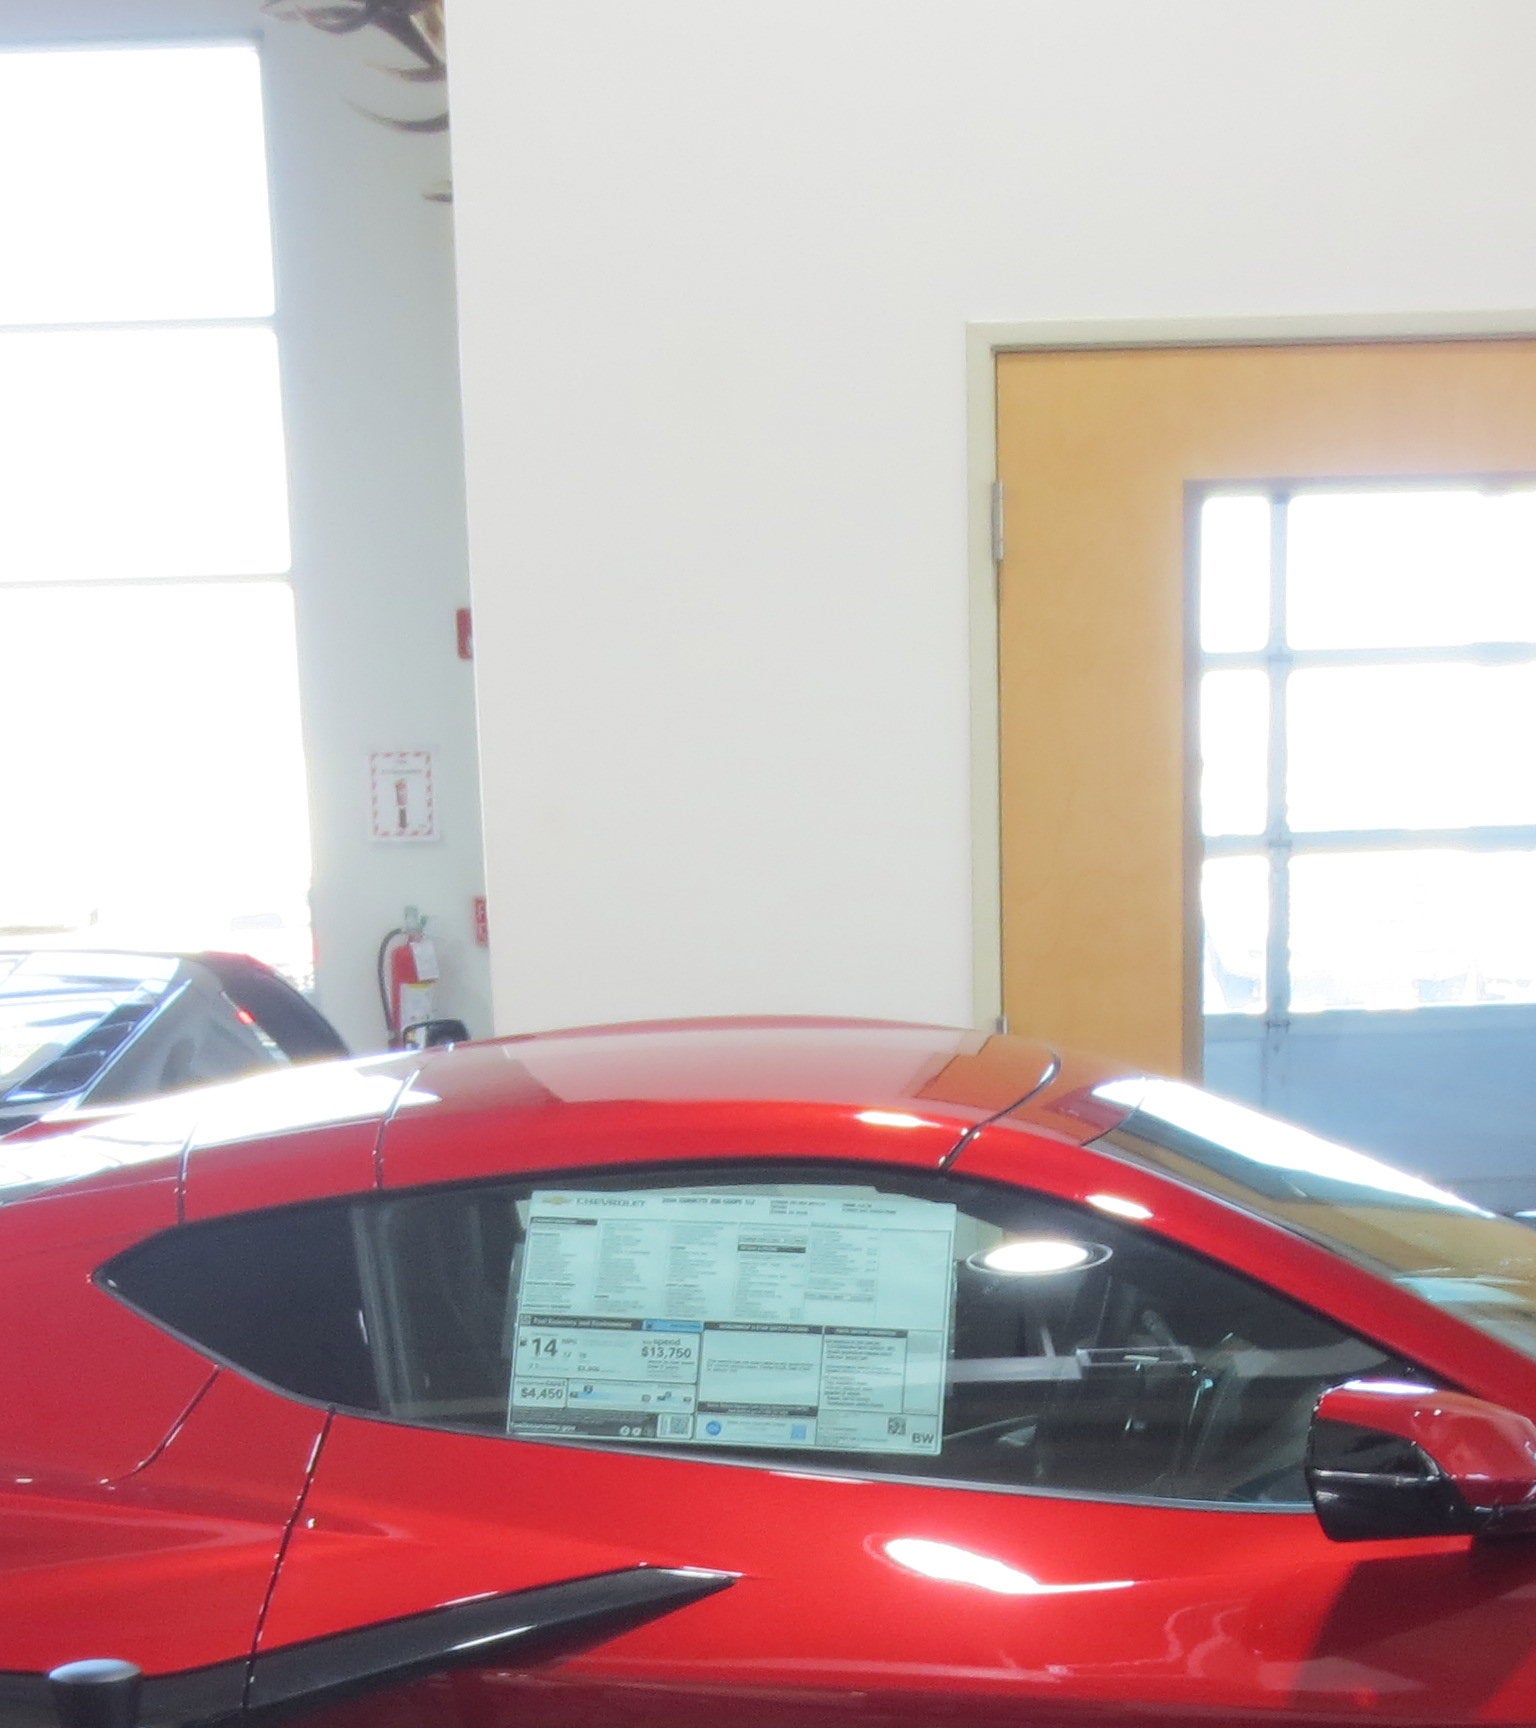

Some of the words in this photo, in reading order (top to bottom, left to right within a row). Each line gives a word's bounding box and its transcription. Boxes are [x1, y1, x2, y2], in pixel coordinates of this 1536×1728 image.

[575, 1197, 646, 1208] CHEVROLET
[532, 1337, 558, 1357] 14
[641, 1346, 692, 1360] $13,750
[521, 1386, 564, 1401] $4,450
[911, 1432, 935, 1445] BW
